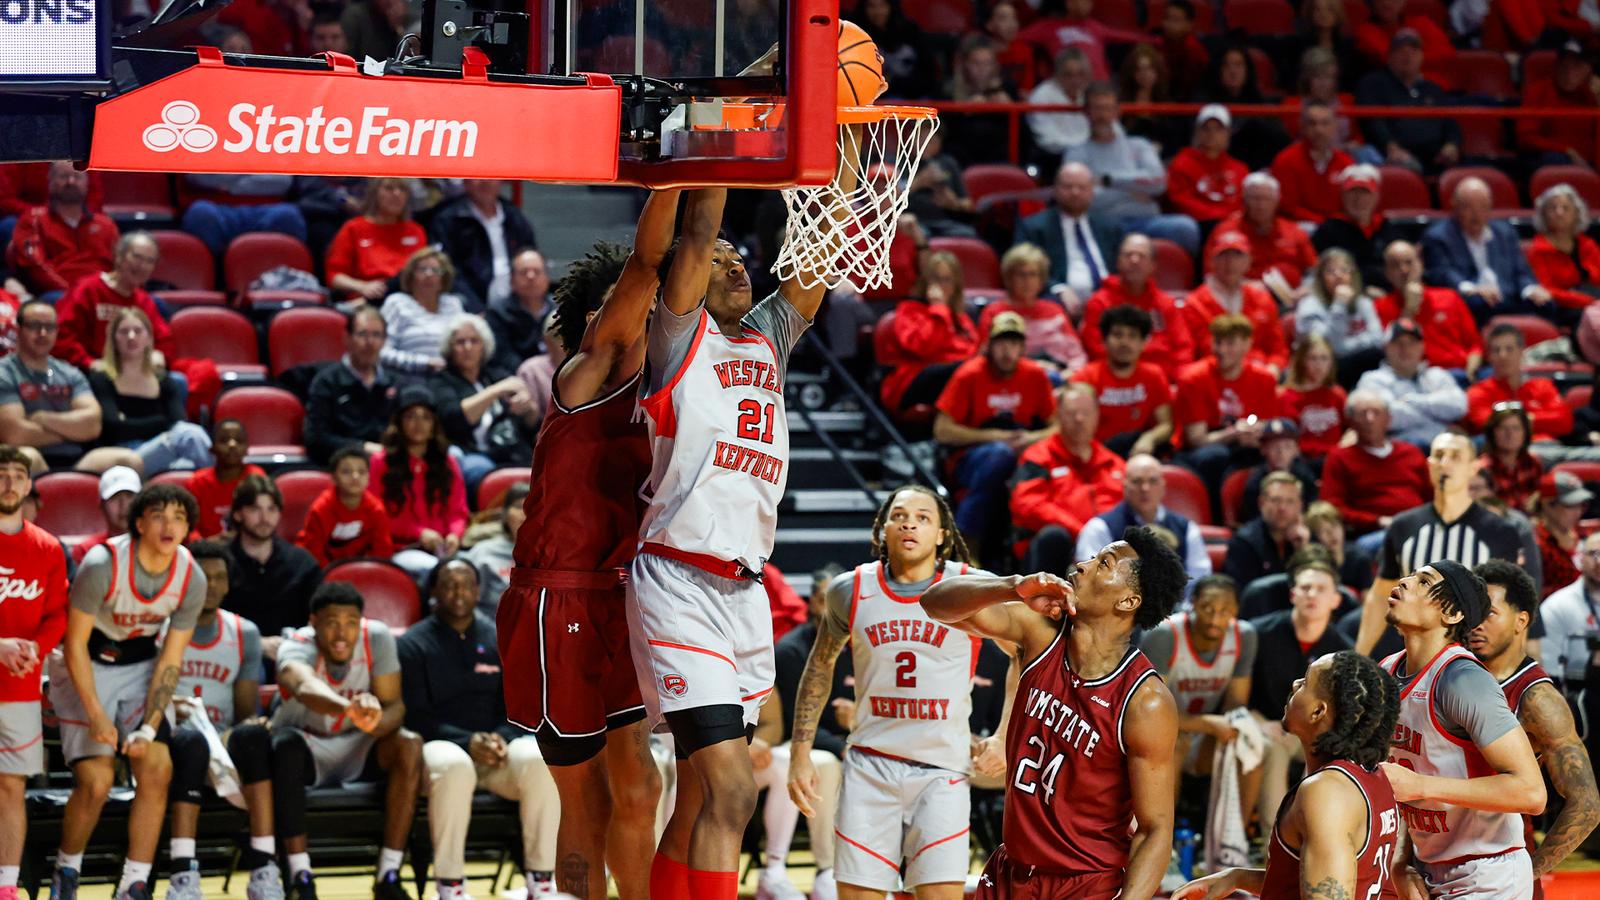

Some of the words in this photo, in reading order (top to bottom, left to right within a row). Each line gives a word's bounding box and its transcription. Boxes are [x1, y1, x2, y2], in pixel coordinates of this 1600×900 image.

[737, 399, 775, 444] 21
[0, 566, 44, 604] ops
[864, 619, 949, 648] WESTERN
[895, 651, 916, 688] 2
[869, 696, 949, 720] KENTUCKY
[1014, 735, 1065, 806] 24
